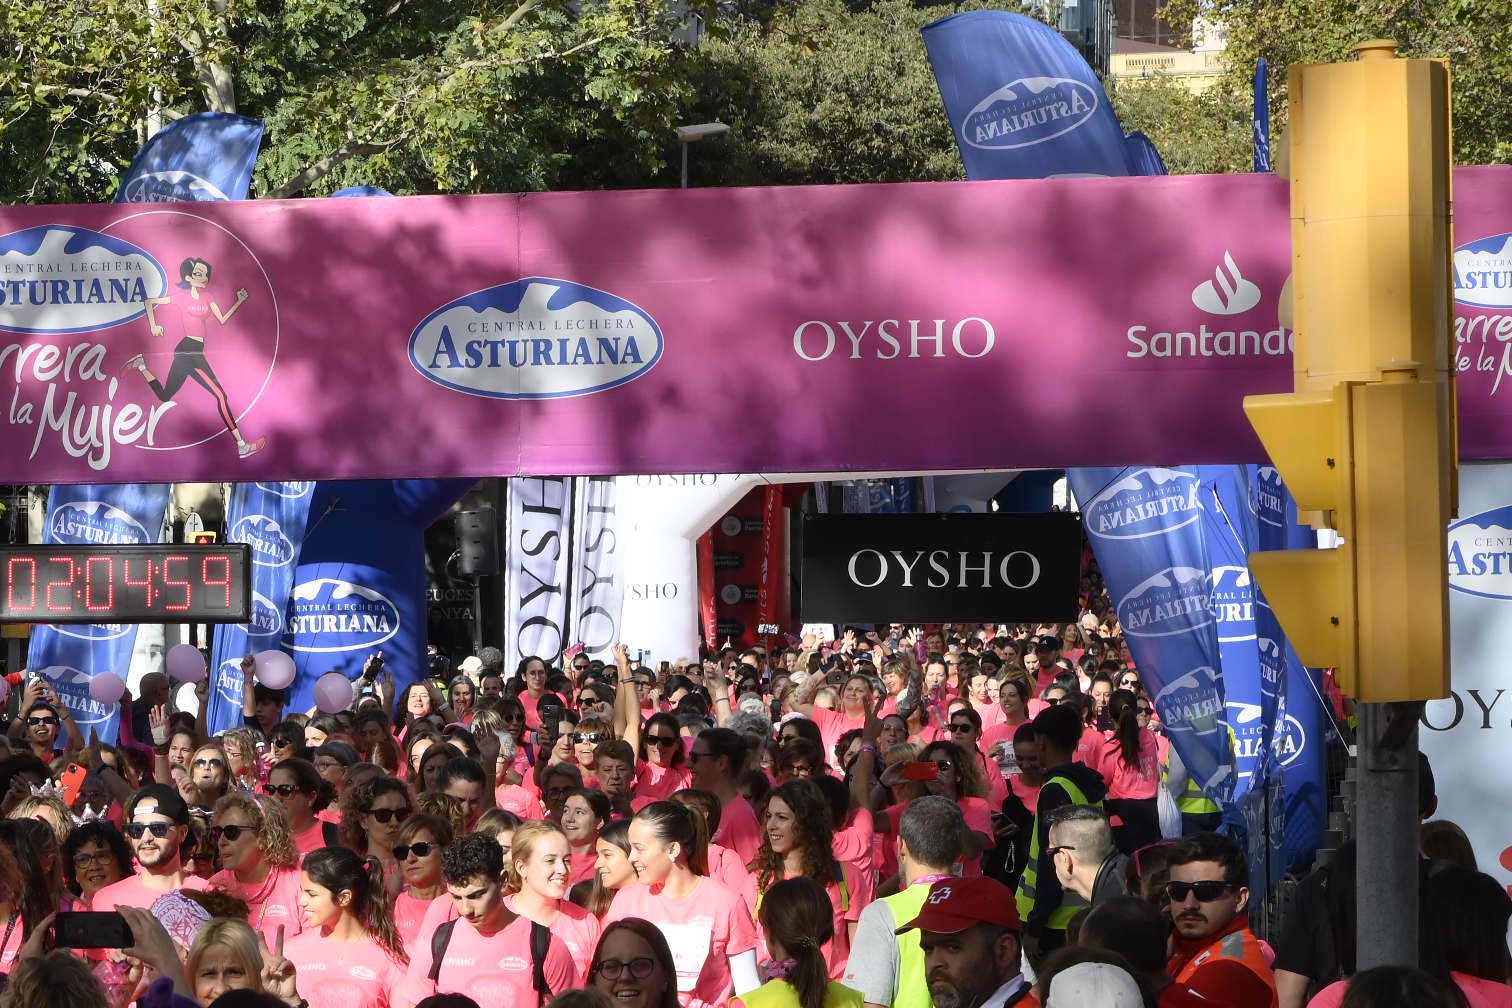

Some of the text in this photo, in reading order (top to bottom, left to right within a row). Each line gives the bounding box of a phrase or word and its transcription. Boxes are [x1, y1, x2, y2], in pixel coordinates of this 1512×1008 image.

[71, 261, 142, 272] LECHERA
[428, 324, 643, 369] ASTURIANA
[467, 319, 635, 333] CENTRAL LECHERA
[792, 317, 996, 361] OYSHO
[1477, 344, 1494, 371] la
[9, 386, 33, 424] la
[29, 376, 177, 470] Mujer
[8, 556, 230, 611] 02:04:59
[848, 548, 1041, 590] OYSHO
[631, 583, 678, 600] SHO
[1421, 689, 1512, 731] OY
